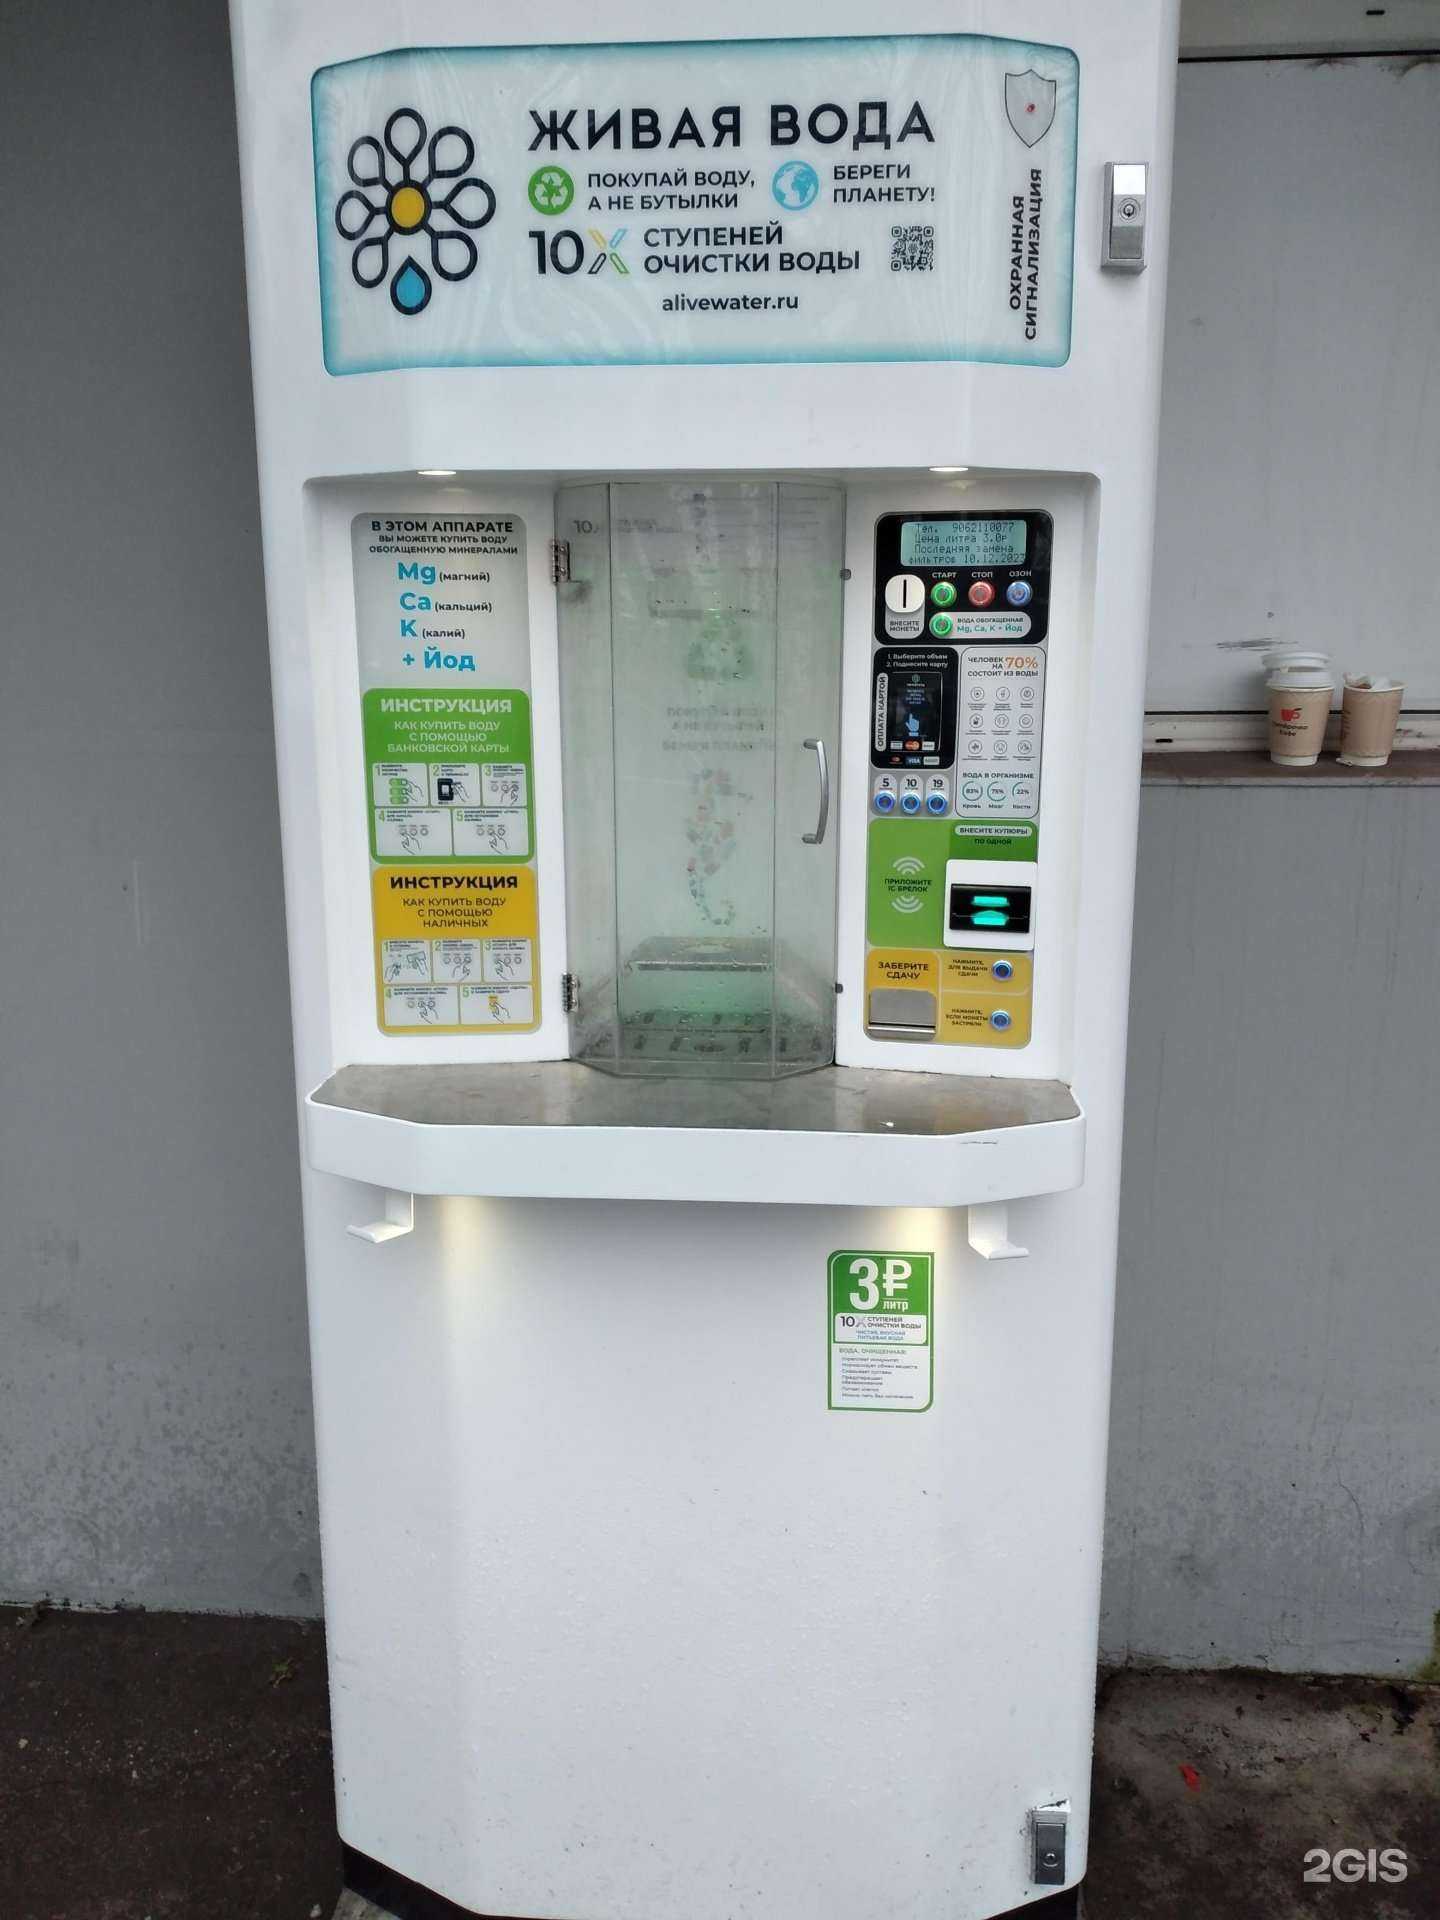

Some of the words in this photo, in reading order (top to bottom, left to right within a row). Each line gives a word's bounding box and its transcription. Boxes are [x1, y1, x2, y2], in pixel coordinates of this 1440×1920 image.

[527, 105, 741, 151] ЖИВАЯ
[770, 100, 936, 151] ВОДА
[587, 167, 687, 188] ПОКУПАЙ
[694, 169, 755, 188] ВОДУ,
[833, 164, 911, 180] БЕРЕГИ
[833, 186, 936, 203] ПЛАНЕТУ!
[588, 195, 601, 211] А
[608, 195, 634, 210] НЕ
[640, 193, 739, 210] БУТЫЛКИ
[643, 221, 783, 247] СТУПЕНЕЙ
[1009, 196, 1025, 310] ОХРАННАЯ
[1025, 168, 1043, 340] СИГНАЛИЗАЦИЯ
[644, 252, 770, 273] ОЧИСТКИ
[779, 250, 860, 274] ВОДЫ
[662, 293, 799, 312] alivewater.ru
[372, 521, 381, 532] В
[386, 521, 427, 532] ЭТОМ
[432, 522, 513, 533] АППАРАТЕ
[916, 523, 938, 533] Тел.
[952, 522, 1014, 533] 9062110077
[379, 535, 394, 543] ВЫ
[397, 535, 438, 543] МОЖЕТЕ
[440, 535, 479, 543] КУПИТЬ
[481, 536, 507, 544] ВОДУ
[915, 534, 940, 544] Цена
[945, 534, 977, 543] литра
[369, 546, 446, 555] ОБОГАЩЕННУЮ
[448, 547, 518, 555] МИНЕРАЛАМИ
[914, 544, 970, 554] Последняя
[975, 544, 1014, 553] замена
[398, 562, 436, 585] Mg
[439, 571, 490, 582] (магний)
[400, 592, 432, 611] Ca
[434, 602, 492, 613] (кальций)
[400, 619, 418, 637] K
[422, 629, 465, 639] (калий)
[1005, 624, 1023, 633] Йод
[424, 646, 476, 671] Йод
[1005, 656, 1038, 669] 70%
[878, 676, 886, 711] КАРТОЙ
[381, 699, 512, 715] ИНСТРУКЦИЯ
[394, 721, 417, 730] КАК
[420, 721, 466, 730] КУПИТЬ
[469, 721, 501, 731] ВОДУ
[409, 733, 417, 741] С
[420, 733, 487, 742] ПОМОЩЬЮ
[388, 742, 467, 753] БАНКОВСКОЙ
[471, 744, 510, 753] КАРТЫ
[882, 778, 890, 787] 5
[906, 778, 917, 787] 10
[933, 779, 944, 788] 19
[390, 876, 518, 890] ИНСТРУКЦИЯ
[403, 898, 425, 906] КАК
[428, 898, 472, 906] КУПИТЬ
[475, 898, 506, 907] ВОДУ
[418, 909, 424, 917] С
[428, 909, 493, 917] ПОМОЩЬЮ
[423, 919, 488, 927] НАЛИЧНЫХ
[878, 961, 929, 971] ЗАБЕРИТЕ
[886, 971, 921, 979] СДАЧУ
[883, 1301, 909, 1312] литр
